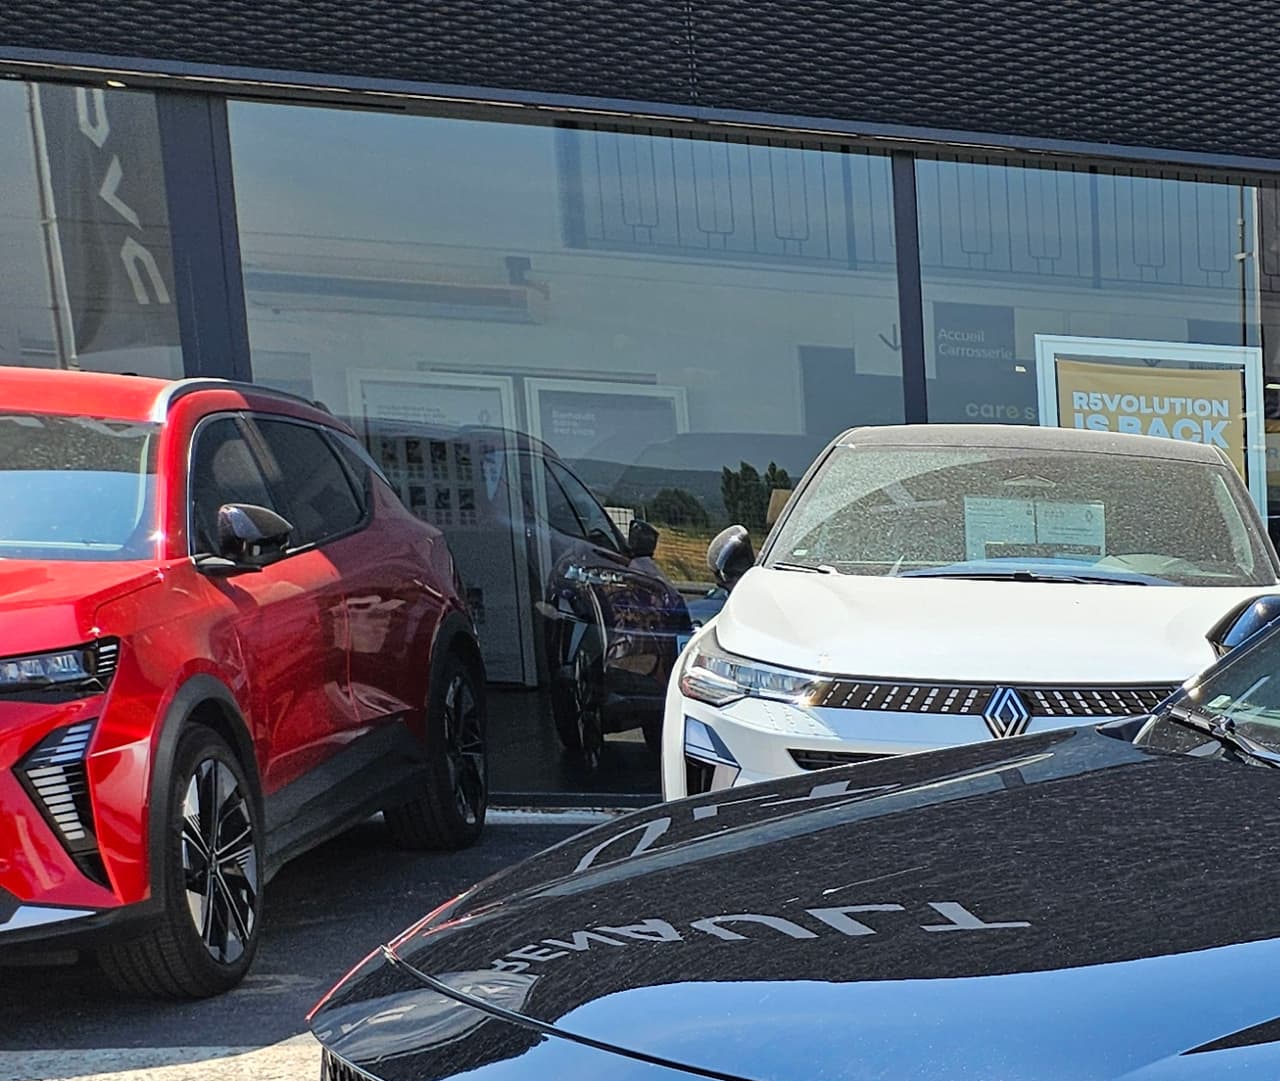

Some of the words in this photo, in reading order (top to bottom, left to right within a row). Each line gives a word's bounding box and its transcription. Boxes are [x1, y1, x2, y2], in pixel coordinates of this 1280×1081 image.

[938, 329, 985, 342] Accueil
[938, 343, 1014, 359] Carrosserie
[965, 403, 1020, 418] care
[1072, 391, 1230, 417] R5VOLUTION
